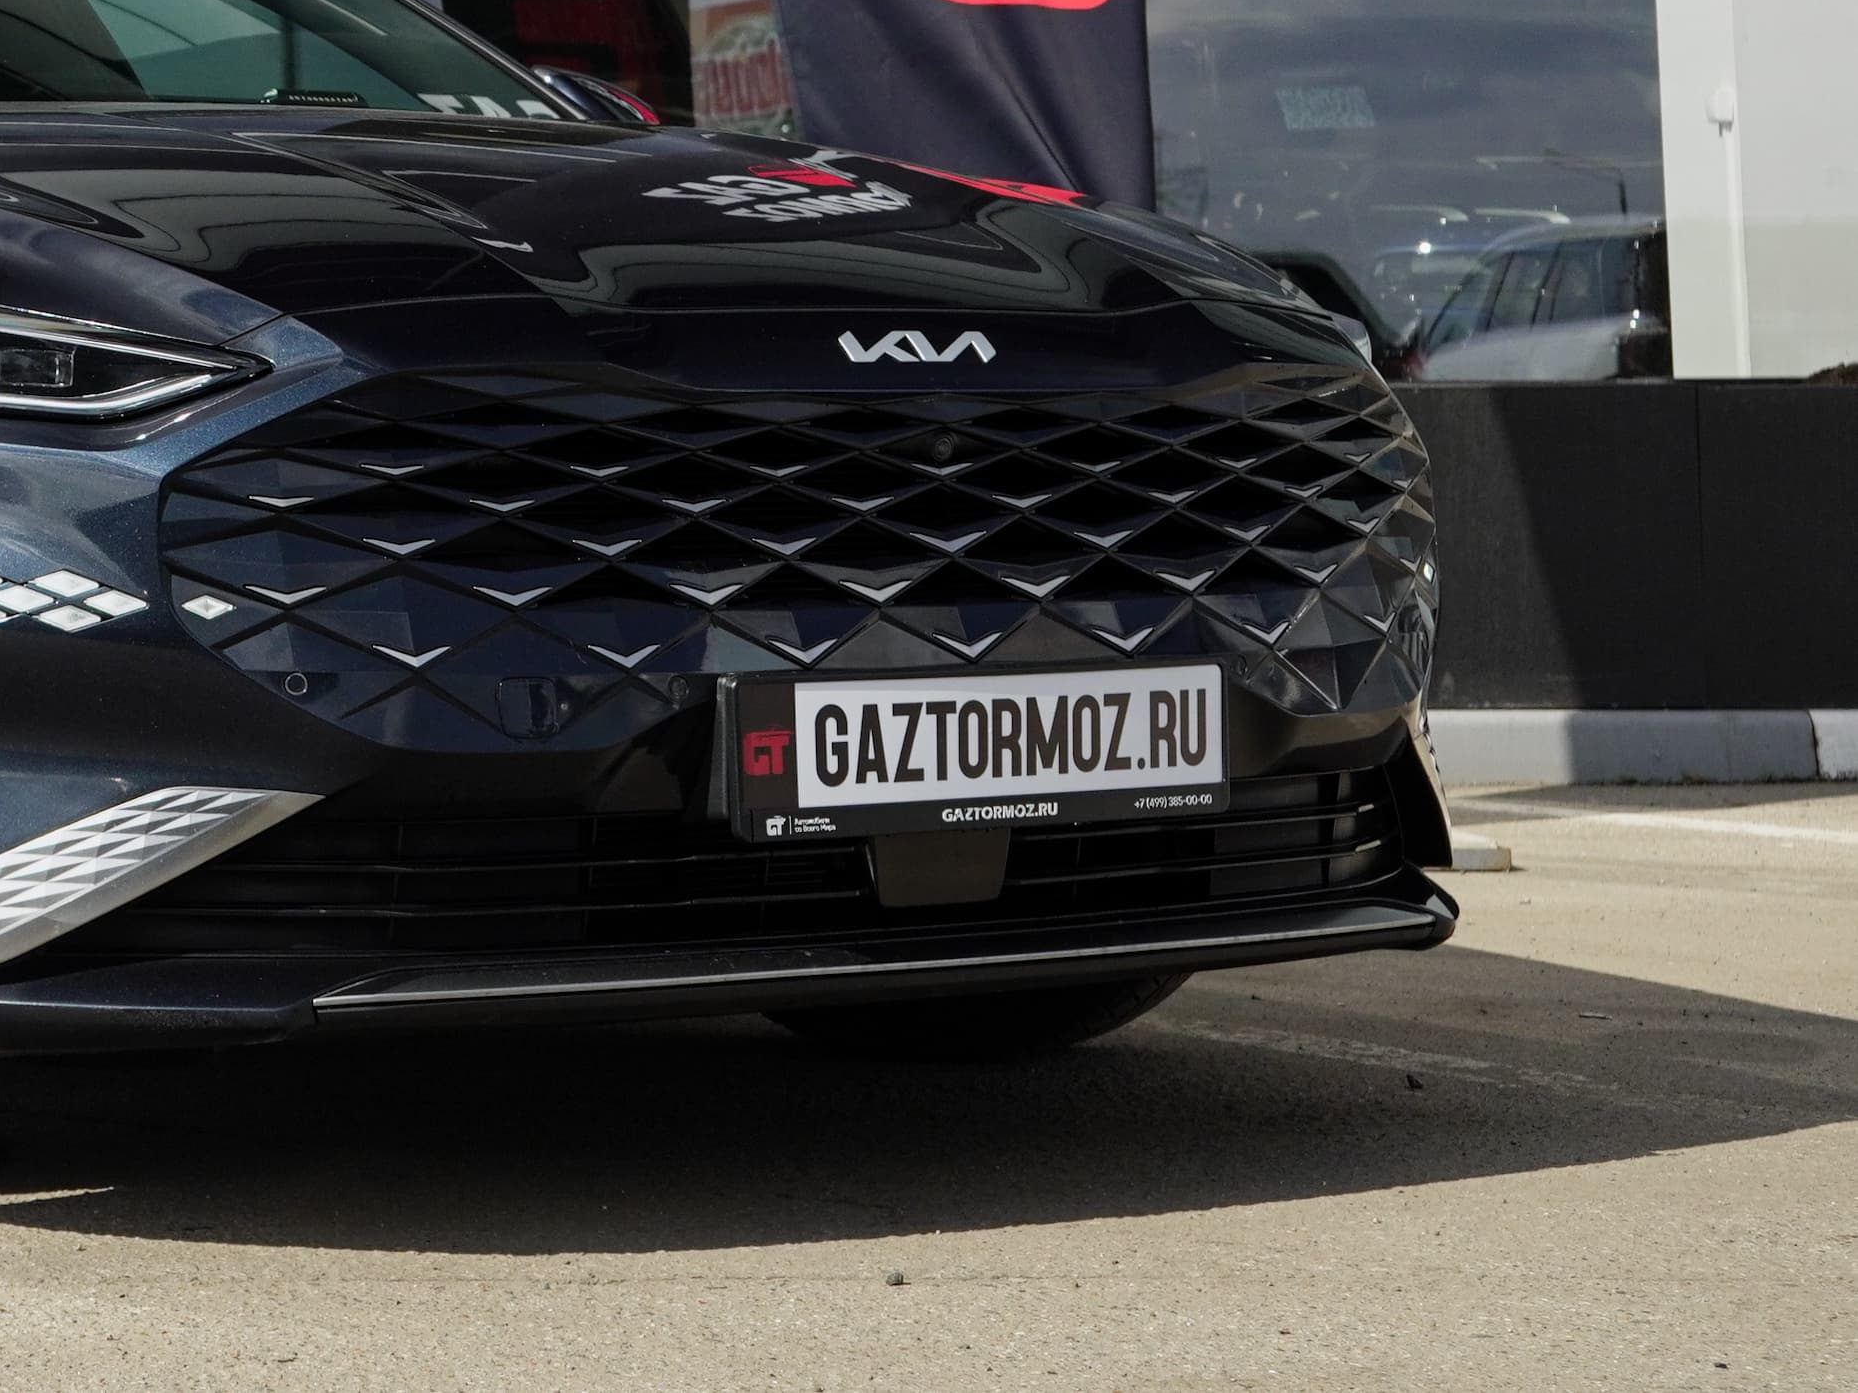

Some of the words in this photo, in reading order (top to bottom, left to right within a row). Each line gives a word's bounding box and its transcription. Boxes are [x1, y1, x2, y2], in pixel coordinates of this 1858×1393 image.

[837, 330, 998, 364] KIA
[744, 726, 792, 776] GT
[814, 687, 1208, 788] GAZTORMOZ.RU
[941, 802, 1058, 823] GAZTORMOZ.RU
[1168, 793, 1213, 807] 385-00-00
[766, 814, 786, 836] GT
